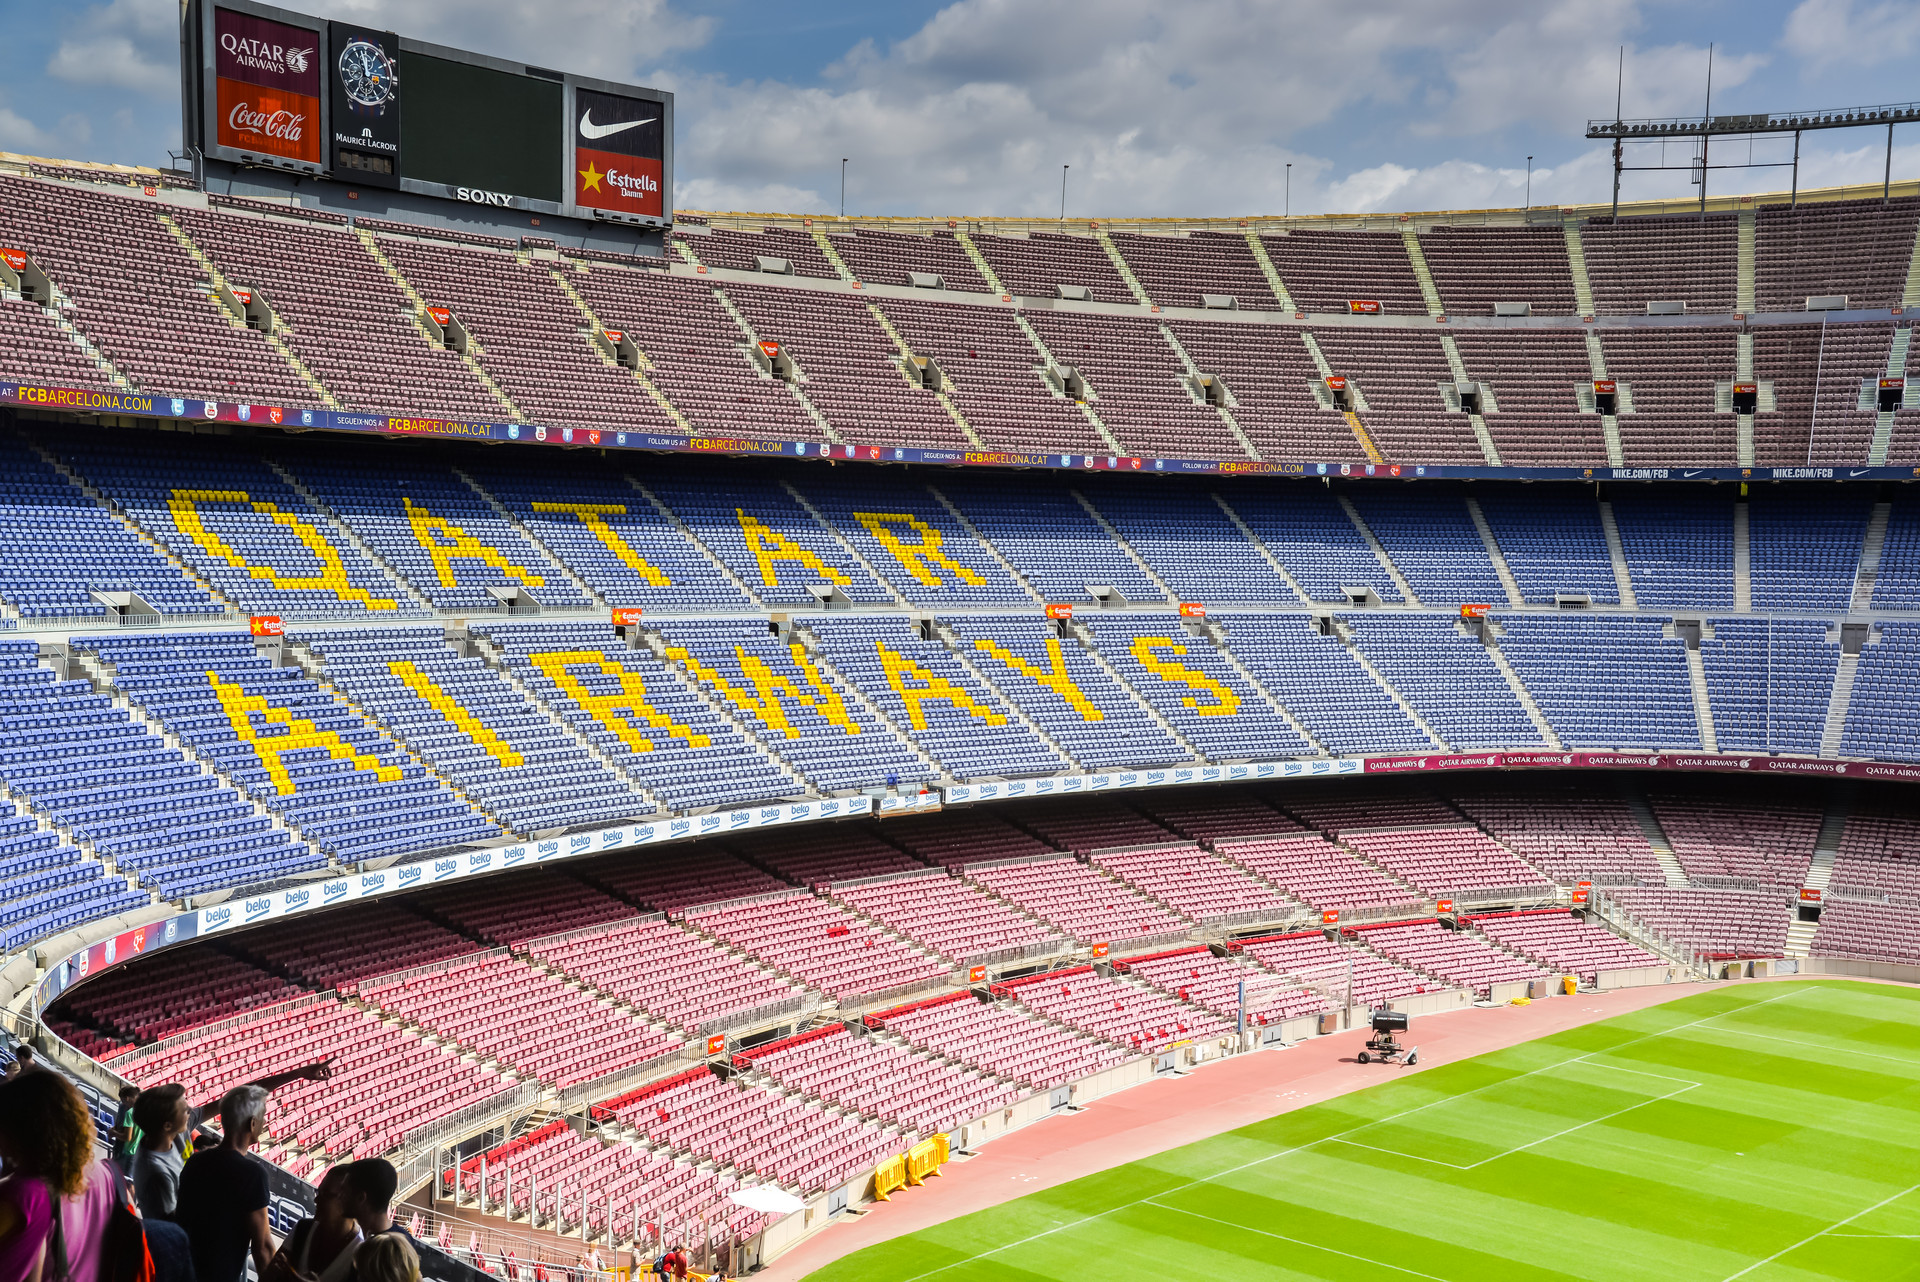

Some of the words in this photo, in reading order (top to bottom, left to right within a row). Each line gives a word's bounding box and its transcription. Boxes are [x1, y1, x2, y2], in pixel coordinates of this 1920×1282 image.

[221, 33, 284, 63] QATAR
[236, 54, 285, 74] AIRWAYS
[229, 102, 306, 142] Coca-Cola
[335, 132, 367, 147] MAURICE
[367, 138, 397, 152] LACROIX
[606, 168, 658, 192] Estrella
[144, 187, 157, 197] 452
[456, 187, 513, 207] SONY
[621, 187, 644, 199] Damm
[18, 386, 153, 412] FCBARCELONA.COM
[337, 416, 377, 427] SEGUEIX-NOS
[388, 418, 492, 436] FCBARCELONA.CAT
[648, 437, 670, 446] FOLLOW
[690, 438, 782, 453] FCBARCELONA.COM
[923, 452, 955, 460] SEGUEIX-NOS
[965, 452, 1048, 465] FCBARCELONA.CAT
[1219, 462, 1304, 473] FCBARCELONA.COM
[1772, 468, 1833, 478] NIKE.COM/FCB
[1612, 468, 1669, 479] NIKE.COM/FCB
[1312, 760, 1330, 770] beko
[1339, 759, 1356, 769] beko
[1370, 761, 1391, 770] QATAR
[1391, 759, 1418, 769] AIRWAYS
[1438, 758, 1459, 767] QATAR
[1460, 757, 1486, 766] AIRWAYS
[1507, 755, 1531, 764] QATAR
[1531, 755, 1562, 763] AIRWAYS
[1588, 757, 1614, 765] QATAR
[1615, 757, 1647, 765] AIRWAYS
[1675, 758, 1703, 766] QATAR
[1704, 759, 1738, 767] AIRWAYS
[1202, 767, 1220, 777] beko
[1230, 765, 1248, 774] beko
[1257, 763, 1275, 773] beko
[1284, 762, 1302, 771] beko
[1769, 761, 1797, 770] QATAR
[1798, 762, 1834, 772] AIRWAYS
[1866, 766, 1895, 776] QATAR
[1119, 772, 1137, 782] beko
[1147, 770, 1165, 780] beko
[1175, 769, 1193, 778] beko
[1036, 779, 1054, 789] beko
[1064, 776, 1081, 786] beko
[1092, 775, 1109, 785] beko
[951, 786, 970, 797] beko
[980, 784, 998, 794] beko
[1008, 781, 1026, 791] beko
[820, 801, 839, 811] beko
[849, 797, 867, 808] beko
[761, 808, 780, 818] beko
[791, 804, 810, 814] beko
[701, 815, 720, 827] beko
[731, 811, 750, 822] beko
[635, 825, 654, 837] beko
[671, 820, 690, 831] beko
[570, 835, 591, 847] beko
[603, 830, 623, 842] beko
[538, 840, 558, 853] beko
[504, 846, 525, 859] beko
[470, 852, 491, 865] beko
[435, 859, 457, 872] beko
[399, 866, 421, 880] beko
[362, 874, 385, 887] beko
[324, 881, 348, 895] beko
[285, 890, 310, 904] beko
[246, 898, 270, 913] beko
[206, 907, 231, 923] beko
